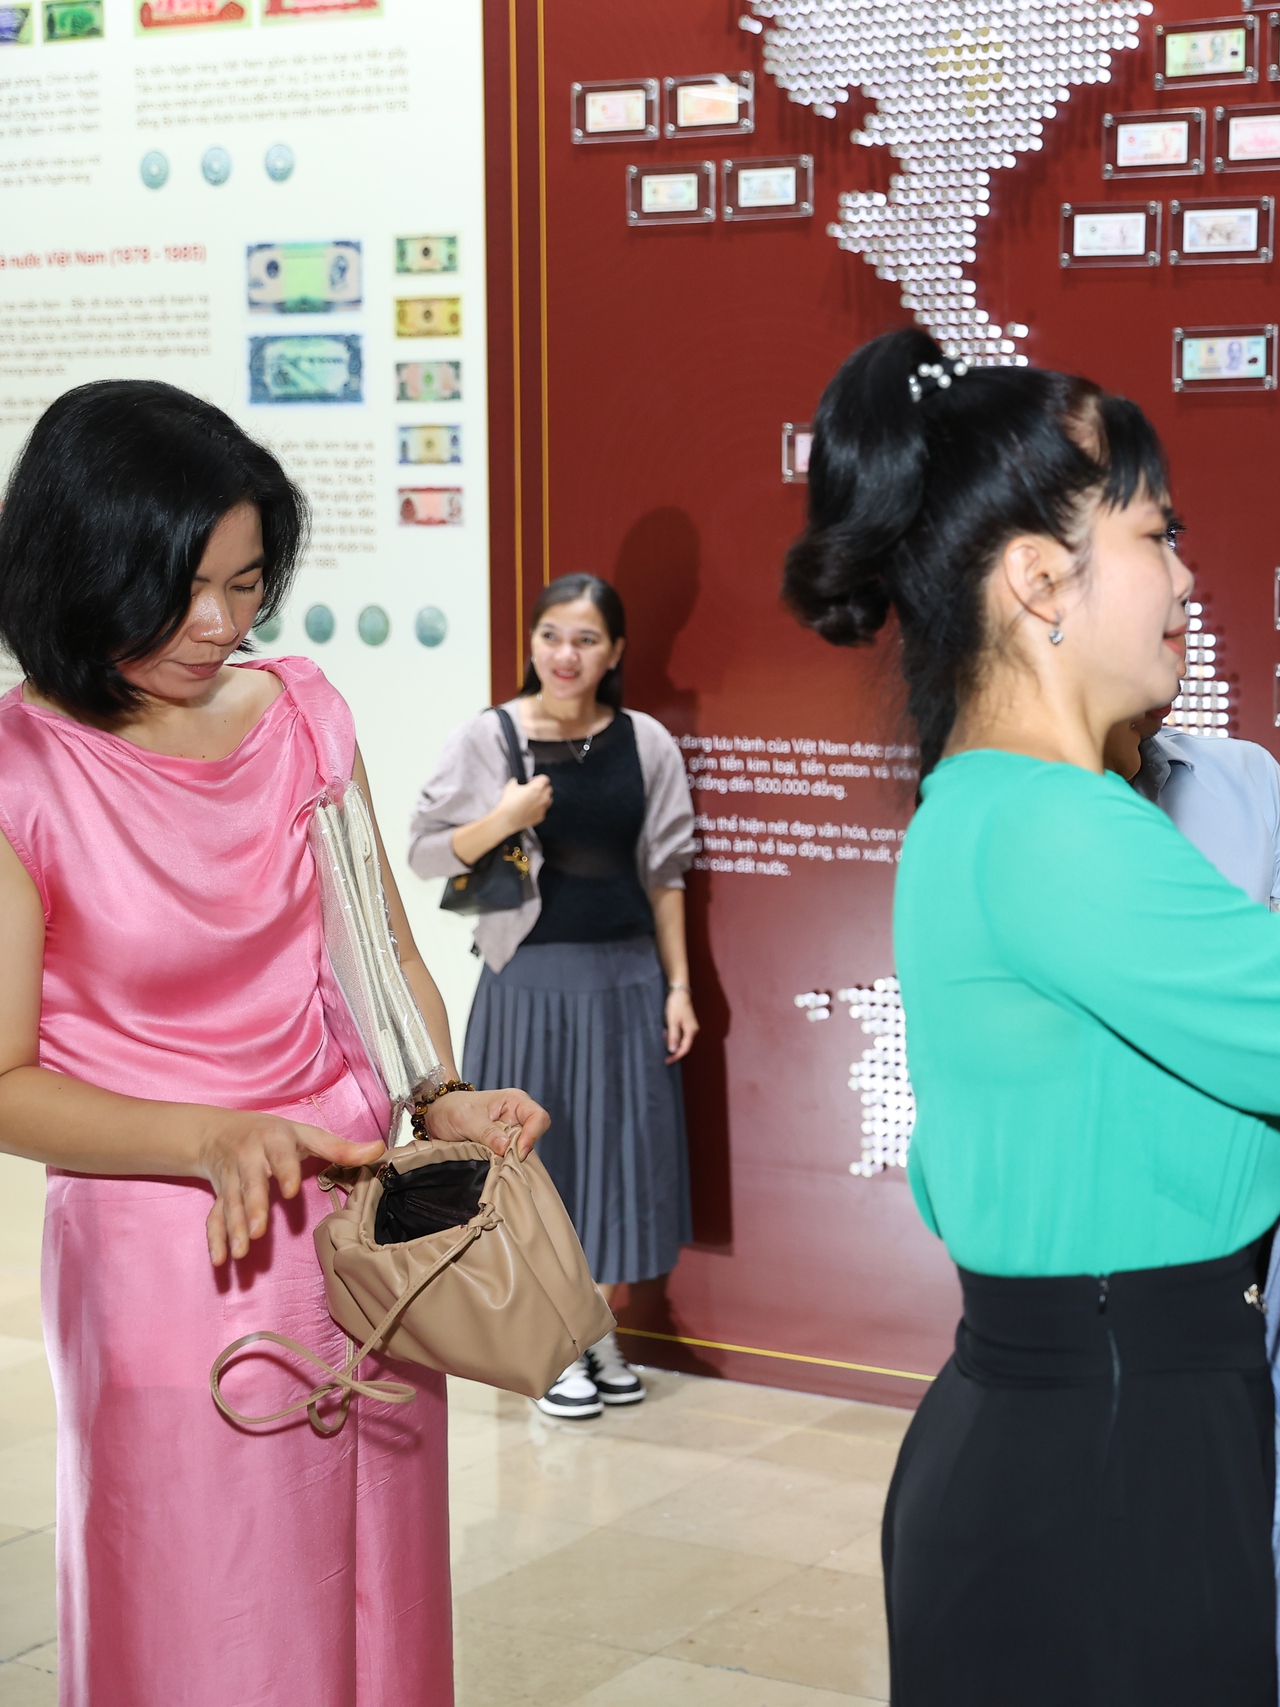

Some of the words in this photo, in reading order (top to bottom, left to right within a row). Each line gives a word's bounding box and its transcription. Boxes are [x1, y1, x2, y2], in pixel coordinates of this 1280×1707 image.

[734, 736, 766, 752] hành
[791, 738, 817, 757] Việt
[818, 739, 849, 756] Nam
[747, 756, 770, 773] kim
[828, 761, 870, 778] cotton
[754, 777, 810, 796] 500.000
